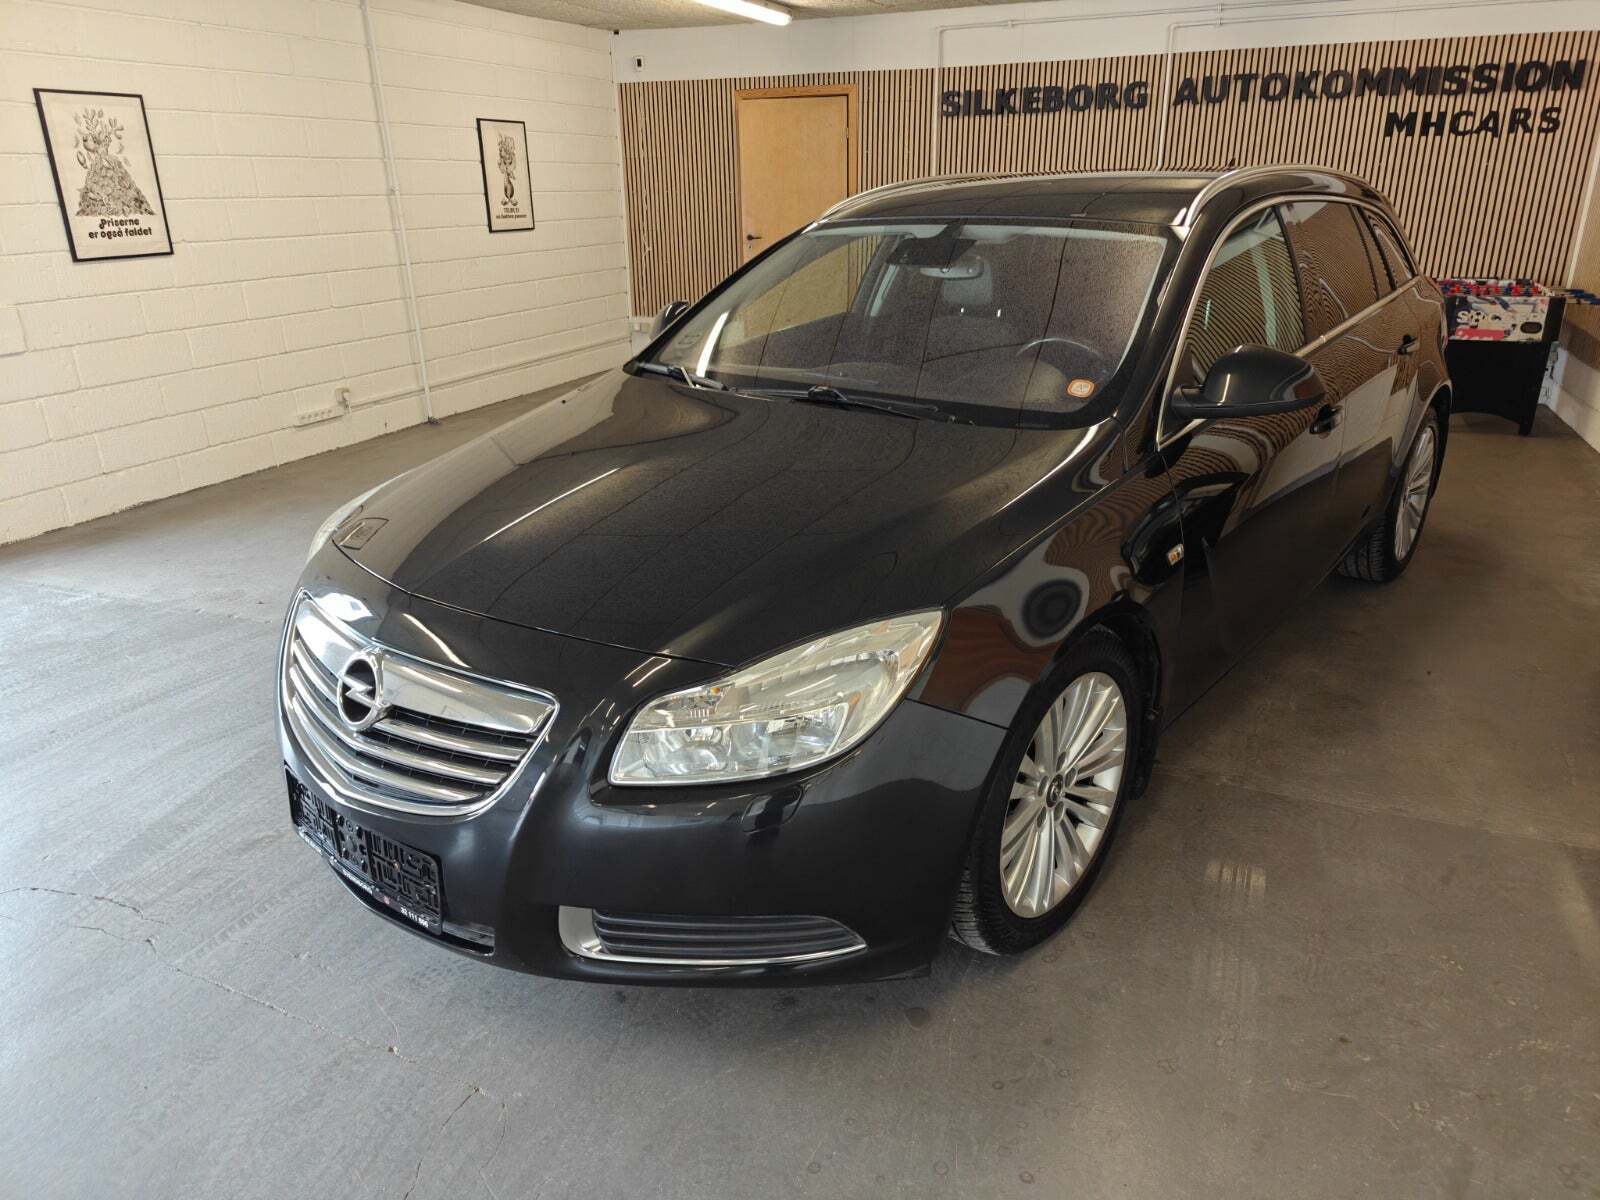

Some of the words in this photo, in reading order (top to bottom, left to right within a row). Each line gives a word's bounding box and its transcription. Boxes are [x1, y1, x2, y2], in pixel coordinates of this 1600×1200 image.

[941, 80, 1149, 117] SILKEBORG
[1173, 58, 1587, 105] AUTOKOMMISSION
[1384, 106, 1561, 138] MHCARS
[88, 231, 98, 239] er
[100, 228, 124, 239] også
[125, 226, 153, 236] faldet
[99, 218, 140, 229] Priserne
